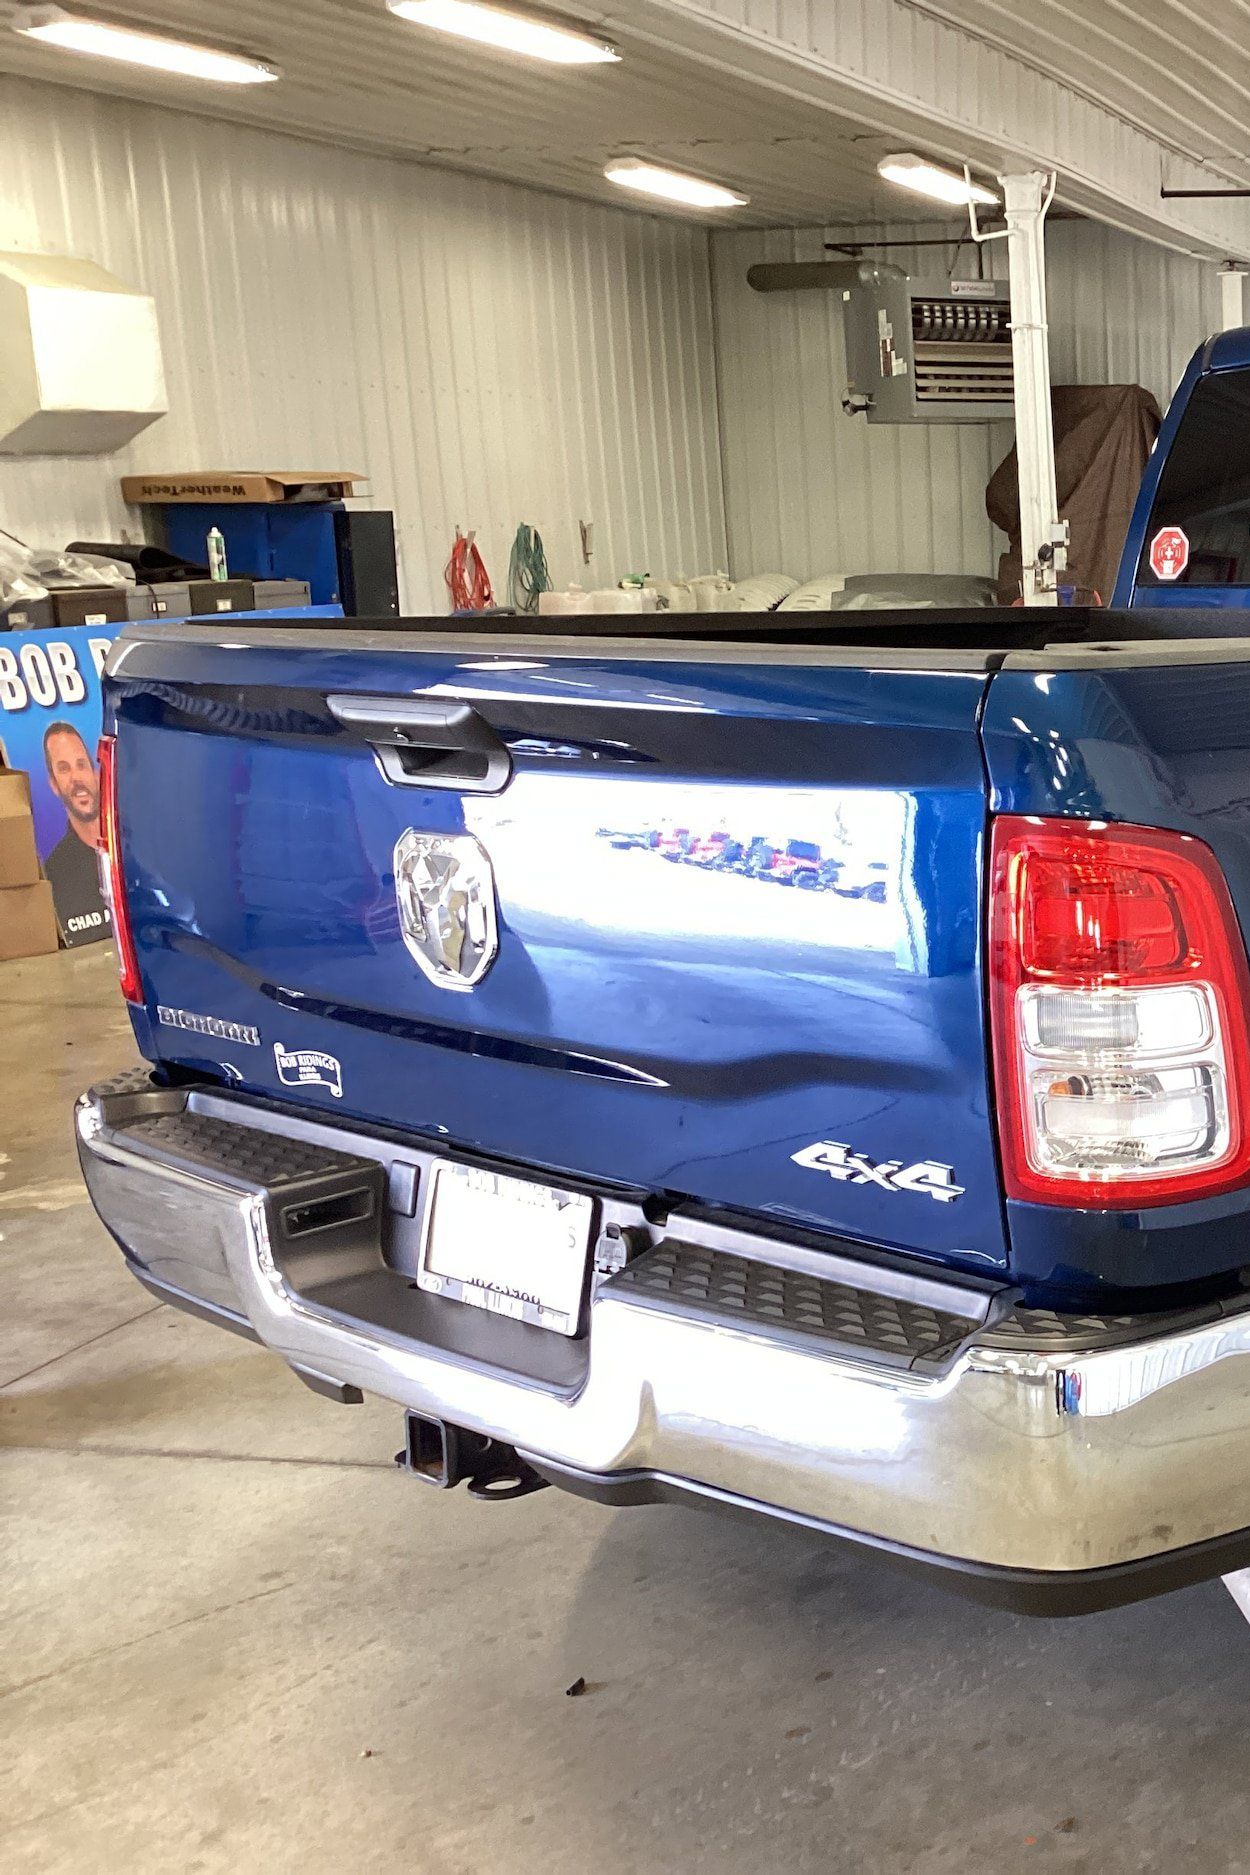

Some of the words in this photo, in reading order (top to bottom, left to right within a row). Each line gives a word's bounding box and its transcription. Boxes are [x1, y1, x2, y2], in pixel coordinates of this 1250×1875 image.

[142, 484, 247, 497] WeatherTech
[0, 641, 86, 710] BOB
[67, 911, 102, 932] CHAD
[280, 1055, 298, 1068] BOB
[297, 1054, 336, 1071] RIDINGS
